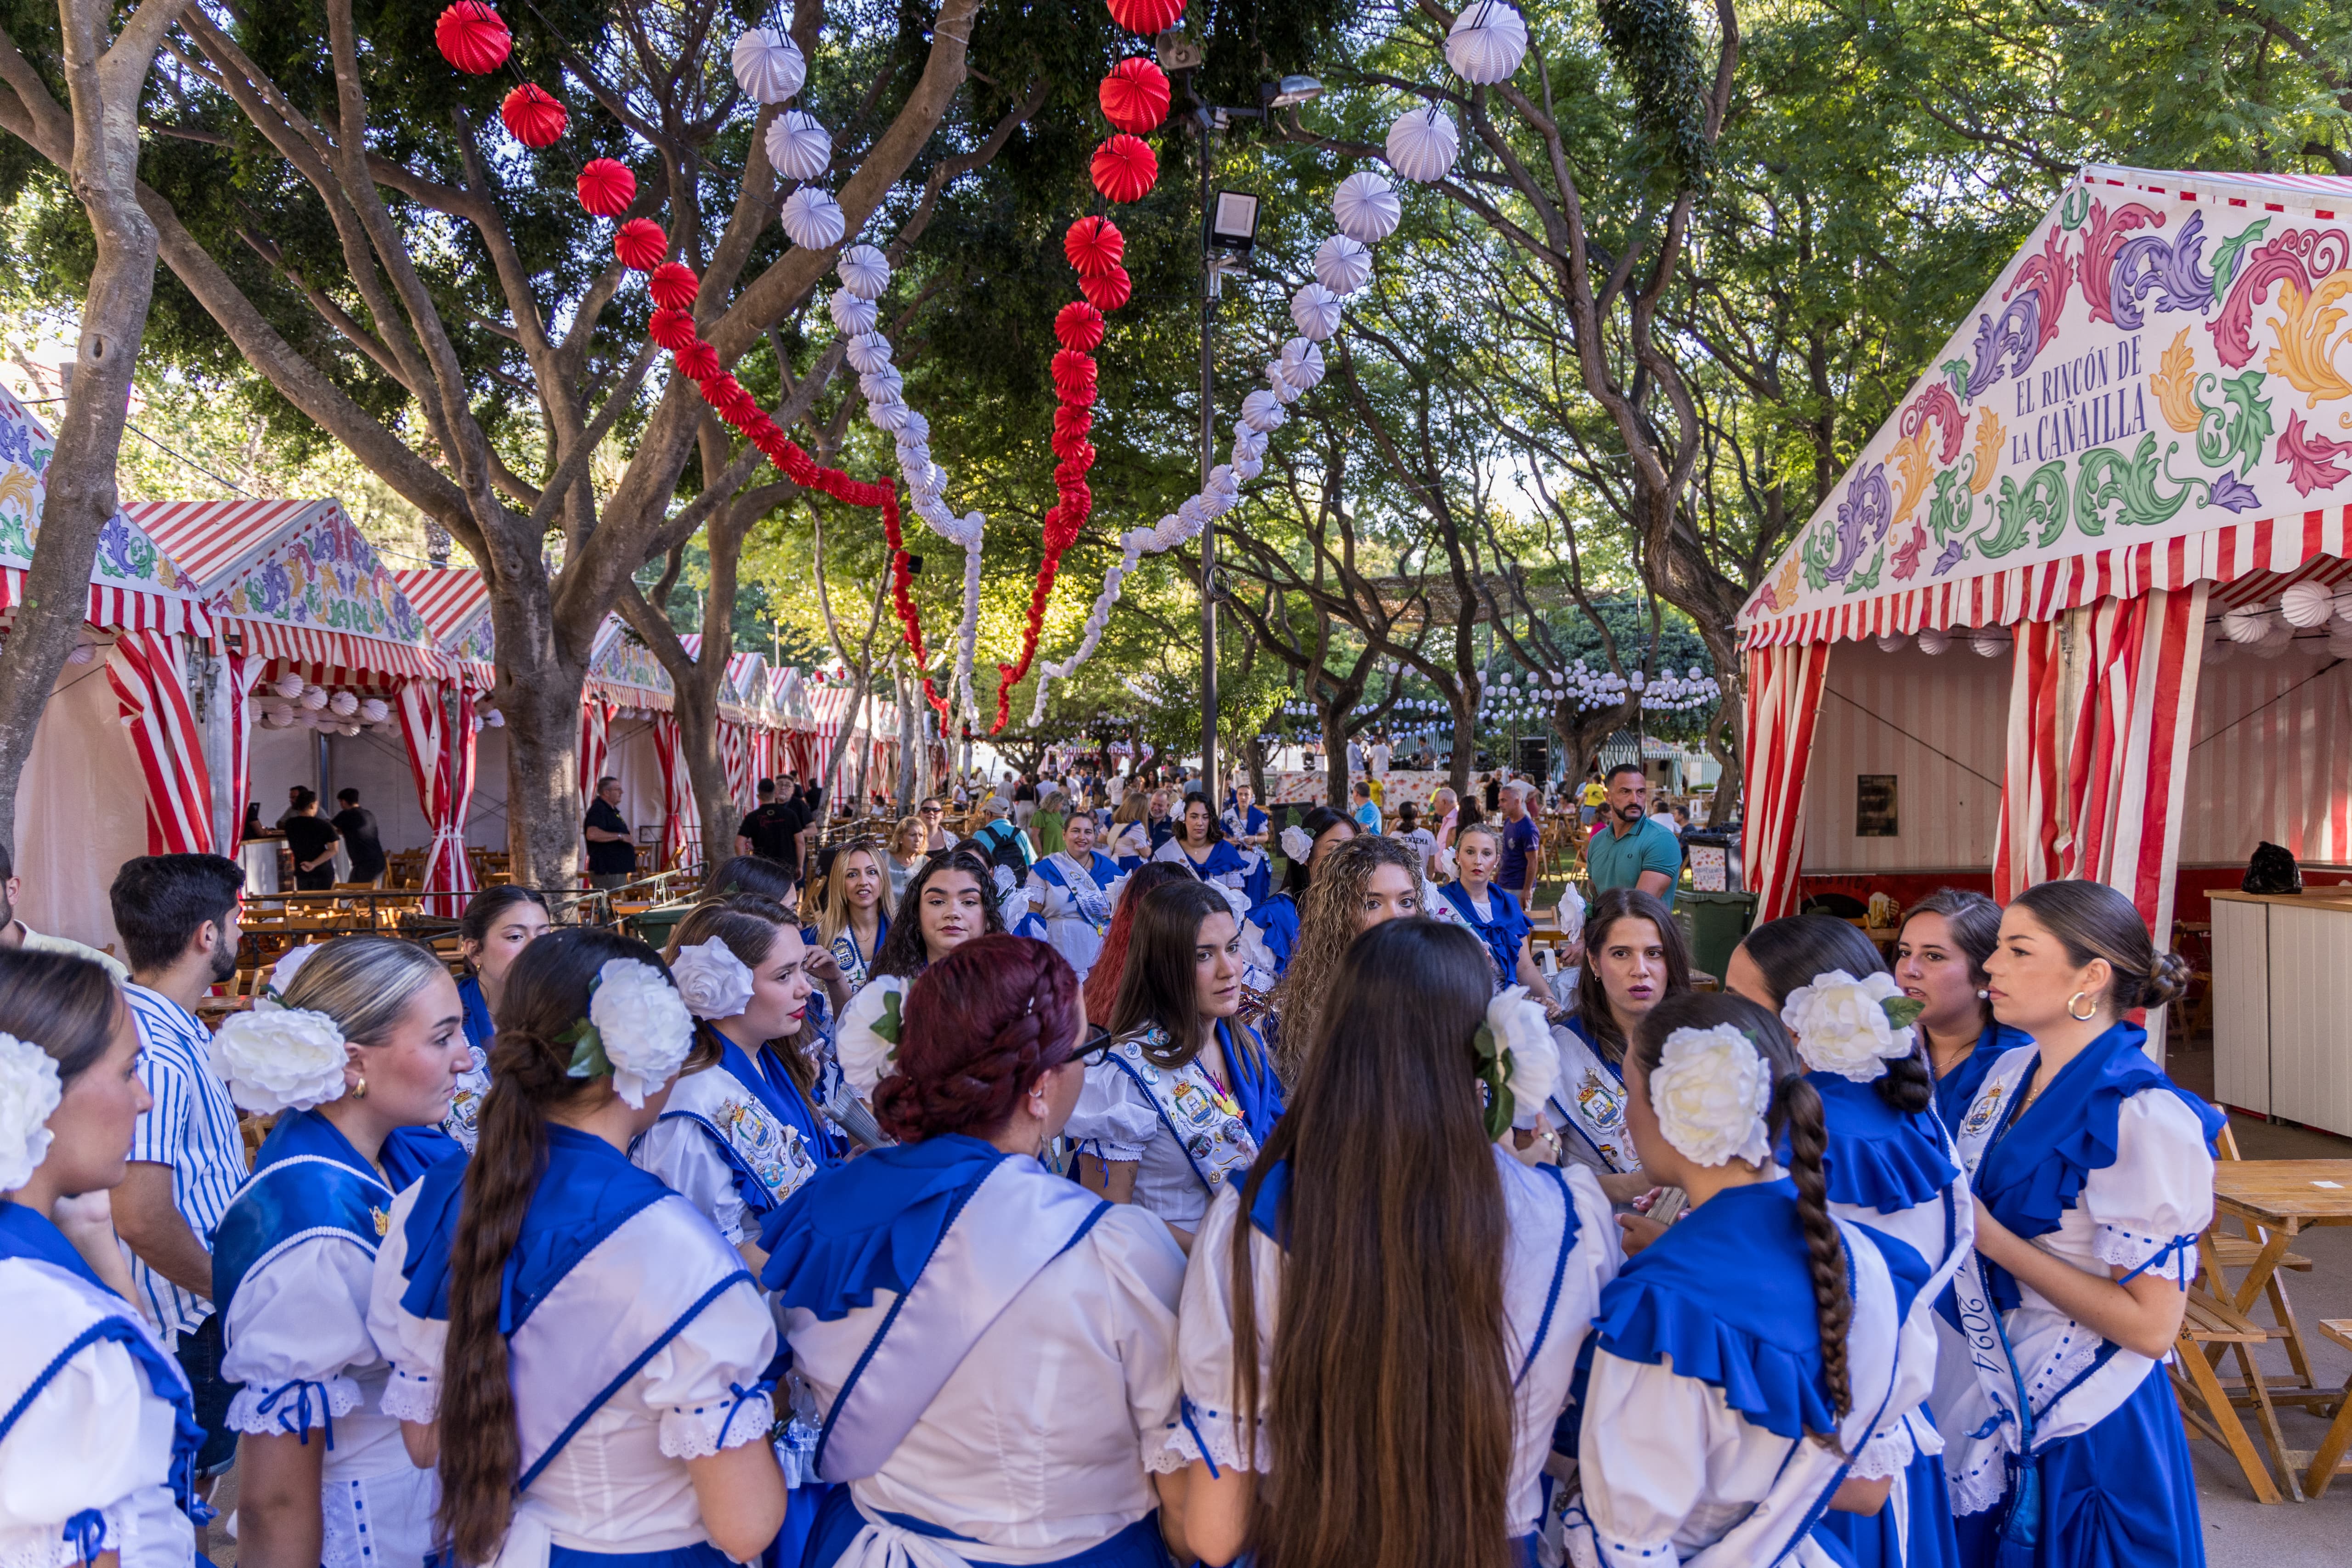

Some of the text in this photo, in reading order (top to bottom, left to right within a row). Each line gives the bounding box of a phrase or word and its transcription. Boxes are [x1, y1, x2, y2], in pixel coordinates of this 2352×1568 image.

[2016, 334, 2142, 417] EL RINCÓN DE
[2012, 382, 2147, 465] LA CAÑAILLA
[1956, 1293, 2005, 1374] 2024
